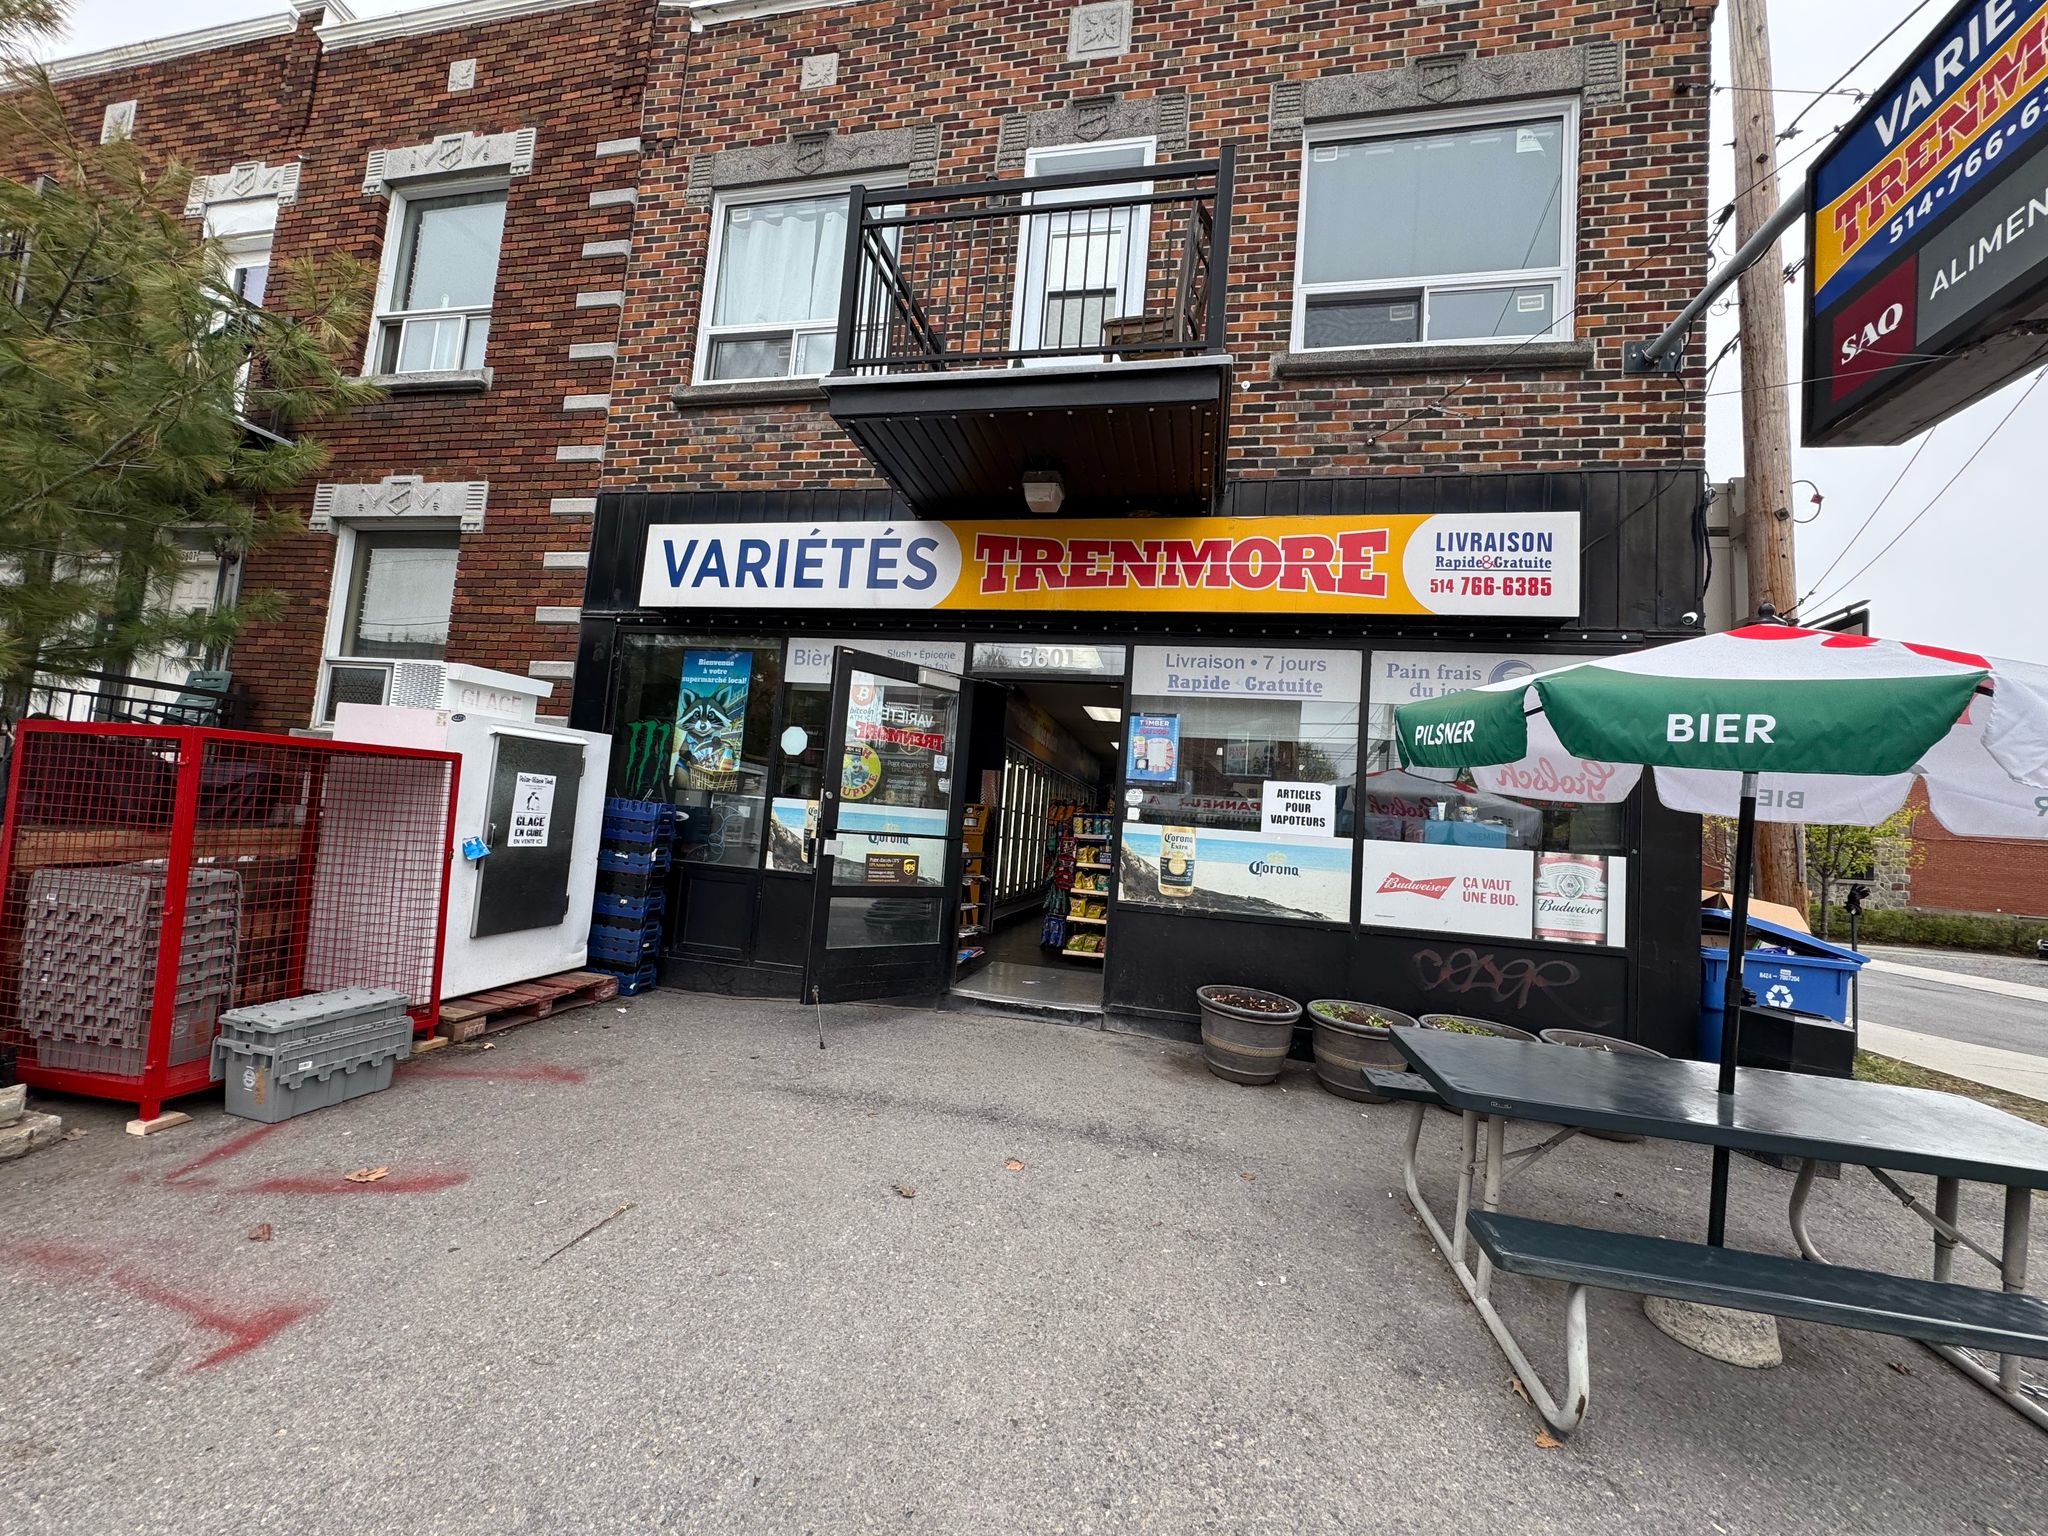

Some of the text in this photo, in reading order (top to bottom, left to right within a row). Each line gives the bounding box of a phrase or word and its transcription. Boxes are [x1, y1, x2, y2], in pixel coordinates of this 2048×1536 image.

[1875, 0, 2033, 148] VARIE
[1834, 12, 2048, 256] TRENM
[1841, 302, 1903, 366] SAQ
[1435, 532, 1553, 552] LIVRAISON
[662, 528, 939, 590] VARIÉTÉS
[974, 527, 1389, 600] TRENMORE
[1430, 576, 1552, 596] 514 766-6385
[698, 658, 735, 666] Bienvenue
[794, 648, 834, 667] Bièr
[887, 648, 956, 660] Slush Épicerie
[1018, 647, 1074, 668] 5601
[1165, 653, 1327, 673] Livraison 7 jours
[682, 676, 727, 684] supermarché
[1386, 663, 1482, 681] Pain frais
[1167, 674, 1323, 694] Rapide Gratuite
[1409, 682, 1434, 698] du
[1415, 720, 1476, 746] PILSNER
[1666, 713, 1777, 744] BIER
[842, 774, 878, 797] UPPIE
[1277, 788, 1322, 801] ARTICLES
[1285, 802, 1312, 814] POUR
[516, 816, 546, 827] GLACE
[1270, 814, 1326, 828] VAPOTEURS
[514, 828, 524, 837] EN
[1164, 832, 1194, 844] Corona
[1171, 842, 1188, 850] Extra
[1249, 860, 1302, 878] Corona
[1383, 876, 1448, 892] Budweiser
[1463, 876, 1512, 892] ÇA VAUT
[1463, 891, 1519, 907] UNE BUD.
[1537, 898, 1604, 915] Budweiser
